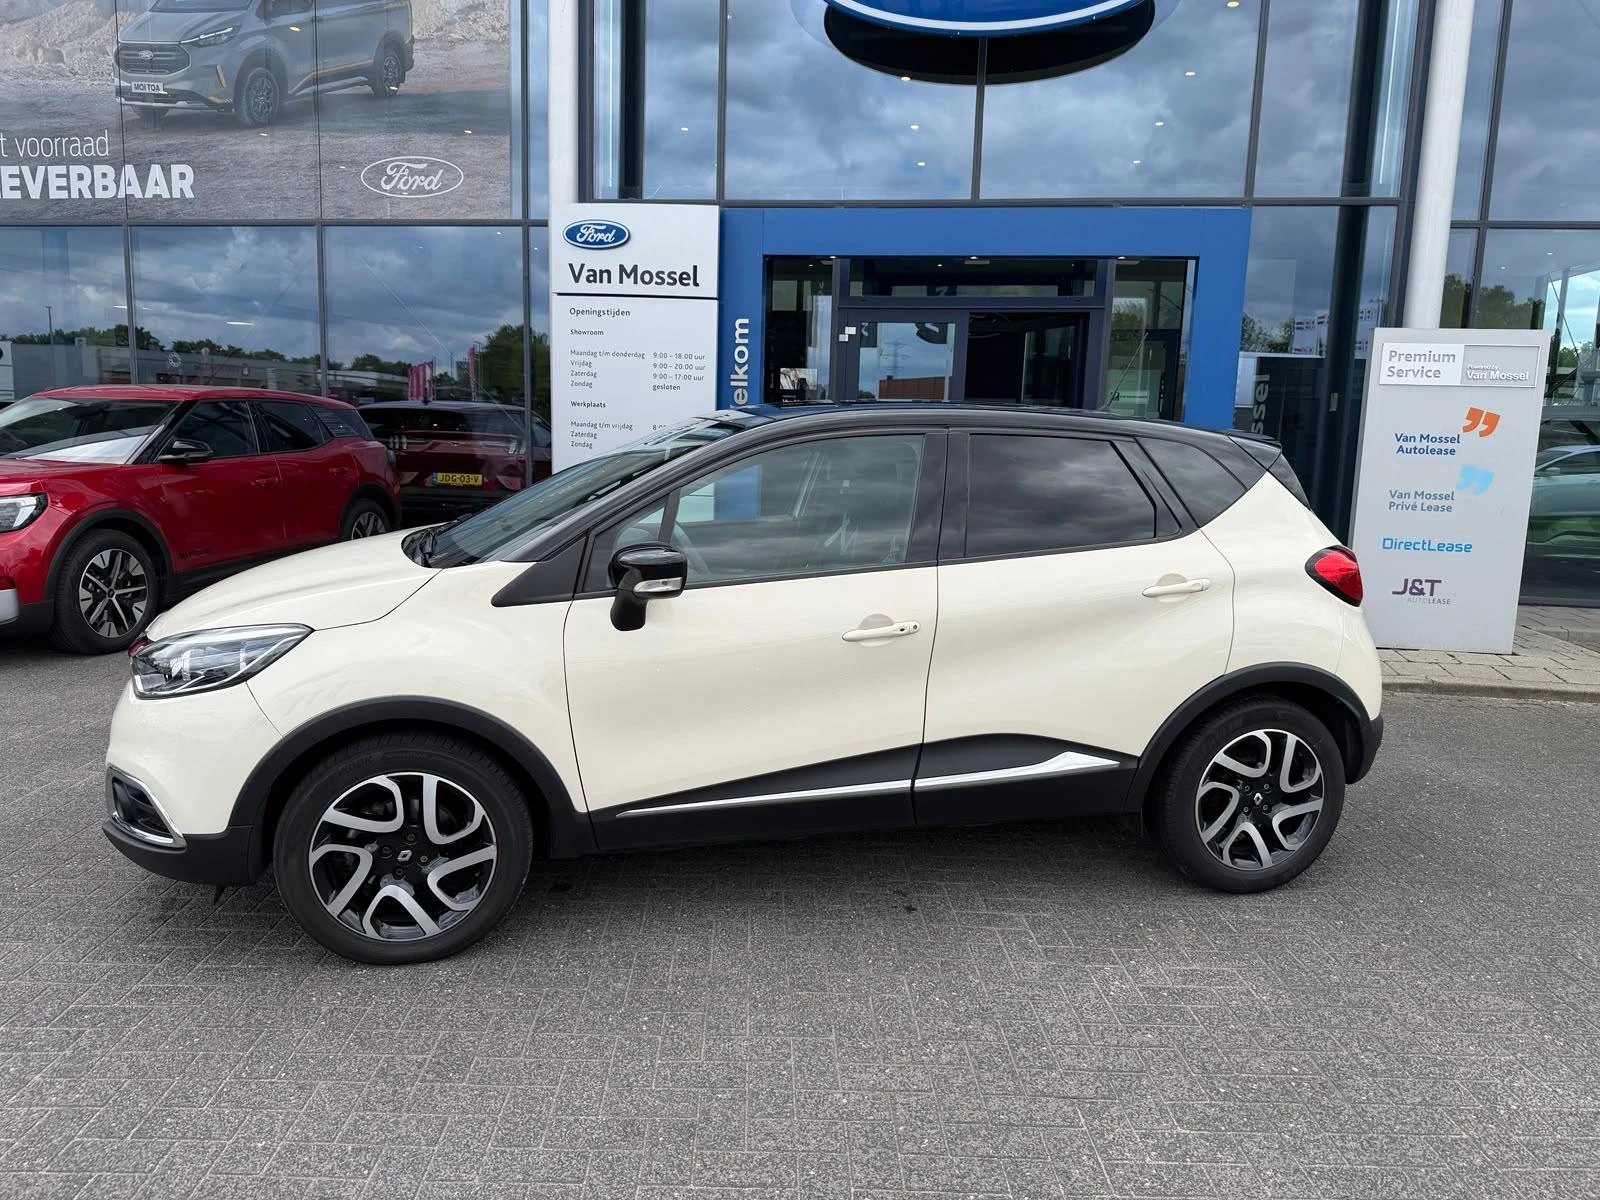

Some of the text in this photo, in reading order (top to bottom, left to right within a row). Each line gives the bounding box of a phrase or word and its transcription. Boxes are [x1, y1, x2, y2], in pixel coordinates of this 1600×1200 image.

[15, 129, 109, 158] voorraad
[0, 164, 195, 199] EVERBAAR
[380, 161, 444, 191] Ford
[576, 224, 616, 243] Ford
[568, 263, 700, 287] Van Mossel
[569, 307, 631, 318] Openingstijden
[570, 328, 604, 336] Showroom
[570, 349, 646, 359] Maandag t/m donderdag
[1388, 350, 1456, 363] Premium
[570, 360, 592, 368] Vrijdag
[730, 318, 749, 409] elkom
[570, 370, 597, 378] Zaterdag
[674, 373, 692, 381] 17:00
[1387, 366, 1441, 378] Service
[1466, 371, 1529, 380] Van Mossel
[570, 380, 593, 388] Zondag
[570, 401, 606, 409] Werkplaats
[570, 421, 598, 429] Maandag
[611, 422, 633, 431] vrijdag
[570, 431, 597, 439] Zaterdag
[1395, 433, 1461, 444] Van Mossel
[570, 441, 593, 449] Zondag
[1396, 445, 1456, 456] Autolease
[440, 473, 479, 483] JDG-03-V
[1389, 490, 1455, 501] Van Mossel
[1388, 501, 1453, 512] Privé Lease
[1382, 538, 1473, 553] DirectLease
[1391, 578, 1442, 597] J&T
